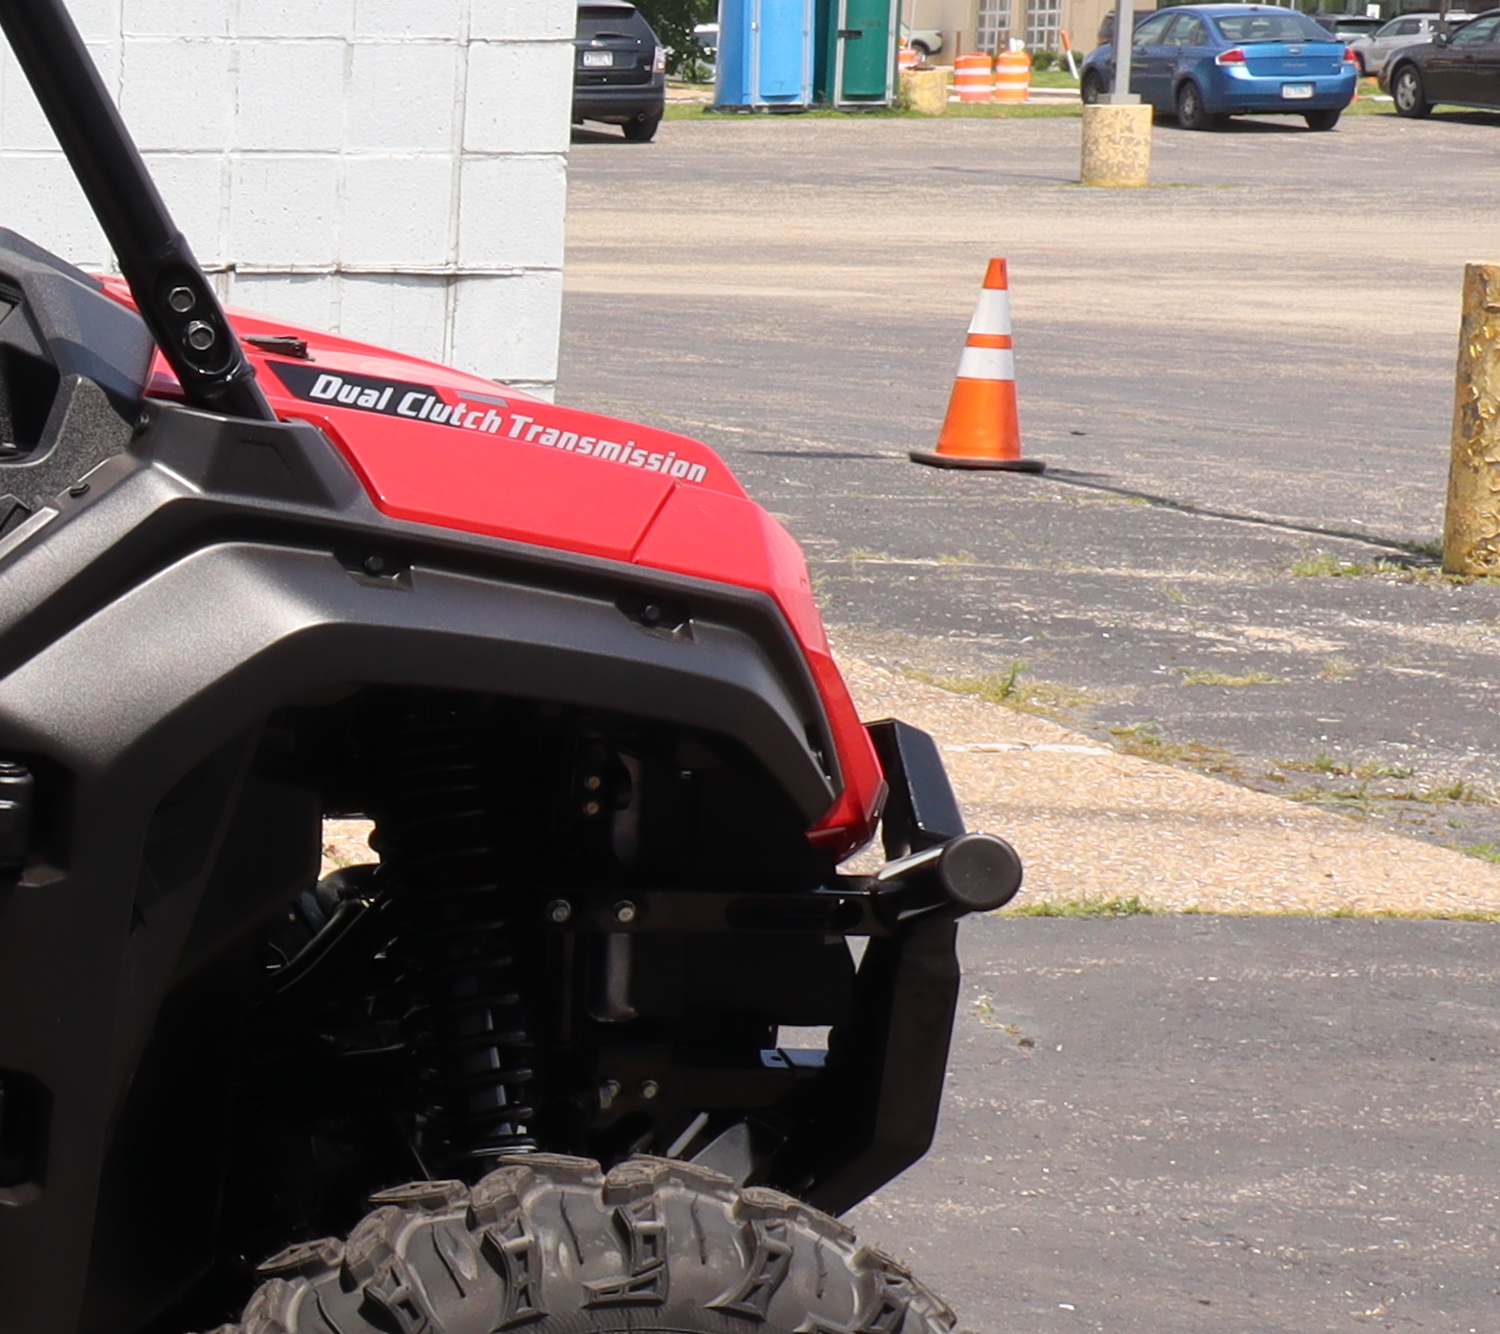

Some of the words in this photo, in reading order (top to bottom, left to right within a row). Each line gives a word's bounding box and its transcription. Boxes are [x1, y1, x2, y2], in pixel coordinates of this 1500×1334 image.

[309, 373, 395, 411] Dual
[396, 391, 505, 435] Clutch
[507, 413, 707, 483] Transmission
